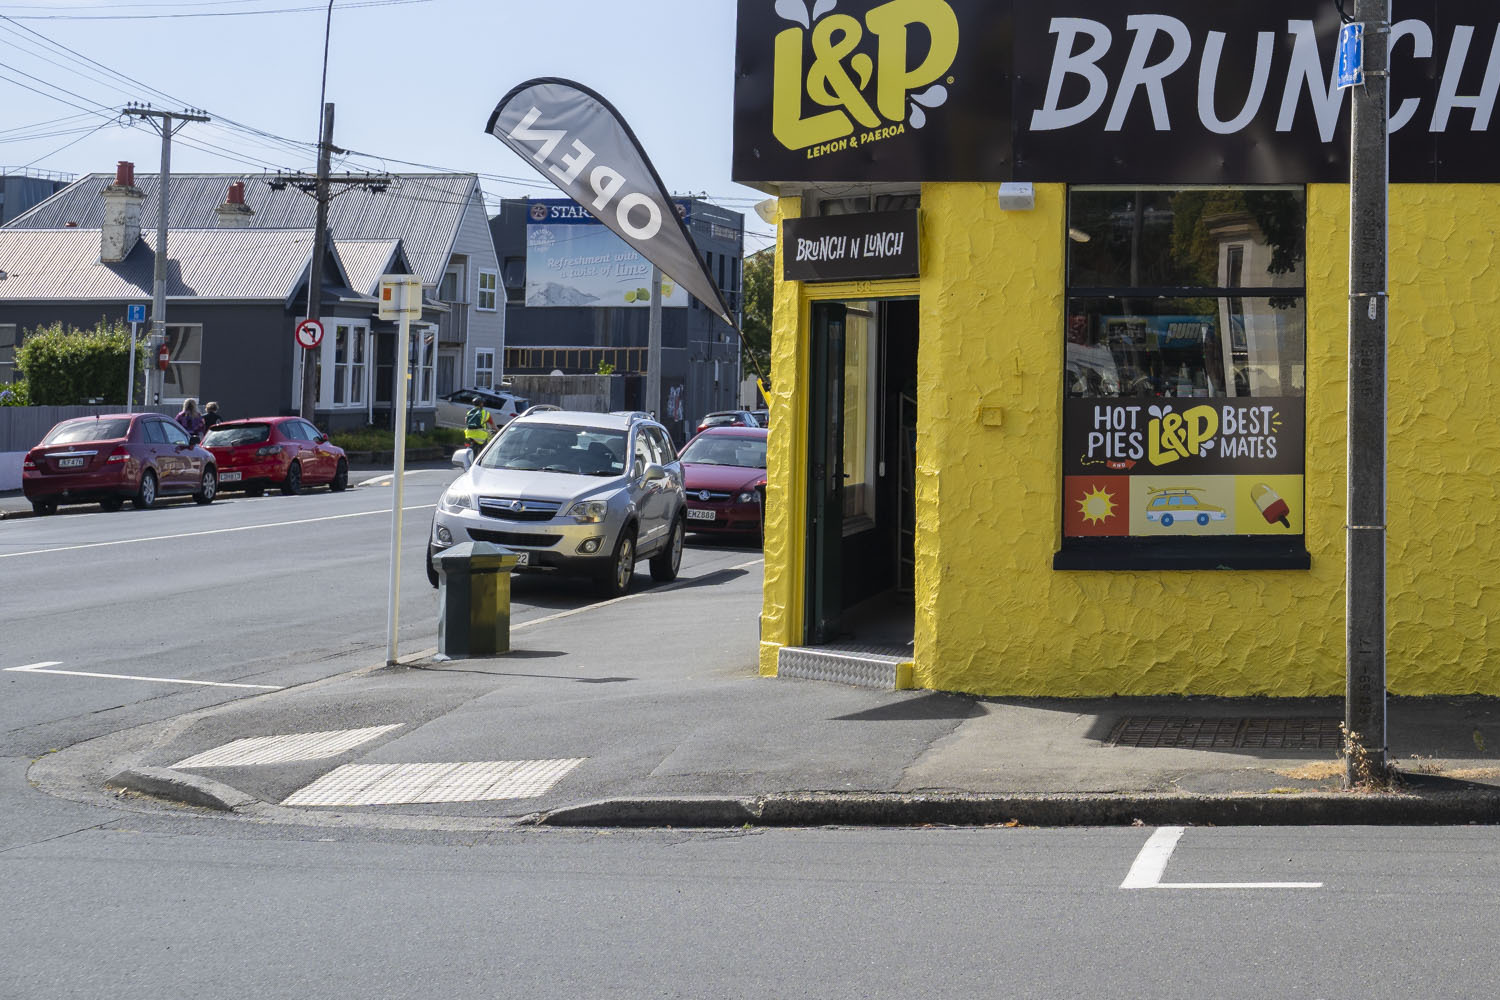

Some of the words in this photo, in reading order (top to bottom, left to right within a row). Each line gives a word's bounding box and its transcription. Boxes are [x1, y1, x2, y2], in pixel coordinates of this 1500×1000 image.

[807, 138, 847, 159] LEMON
[849, 137, 859, 149] &
[860, 123, 905, 144] PAEROA
[547, 254, 610, 270] Refreshment
[615, 251, 638, 263] with
[796, 235, 847, 262] BRUNCH
[850, 238, 861, 259] N
[863, 232, 904, 258] LUNCH
[571, 267, 598, 279] twist
[600, 266, 611, 278] of
[616, 264, 649, 276] lime
[1094, 405, 1141, 430] HOT
[1222, 405, 1273, 435] BEST
[1087, 431, 1144, 460] PIES
[1148, 404, 1219, 466] L&P
[1220, 436, 1277, 459] MATES
